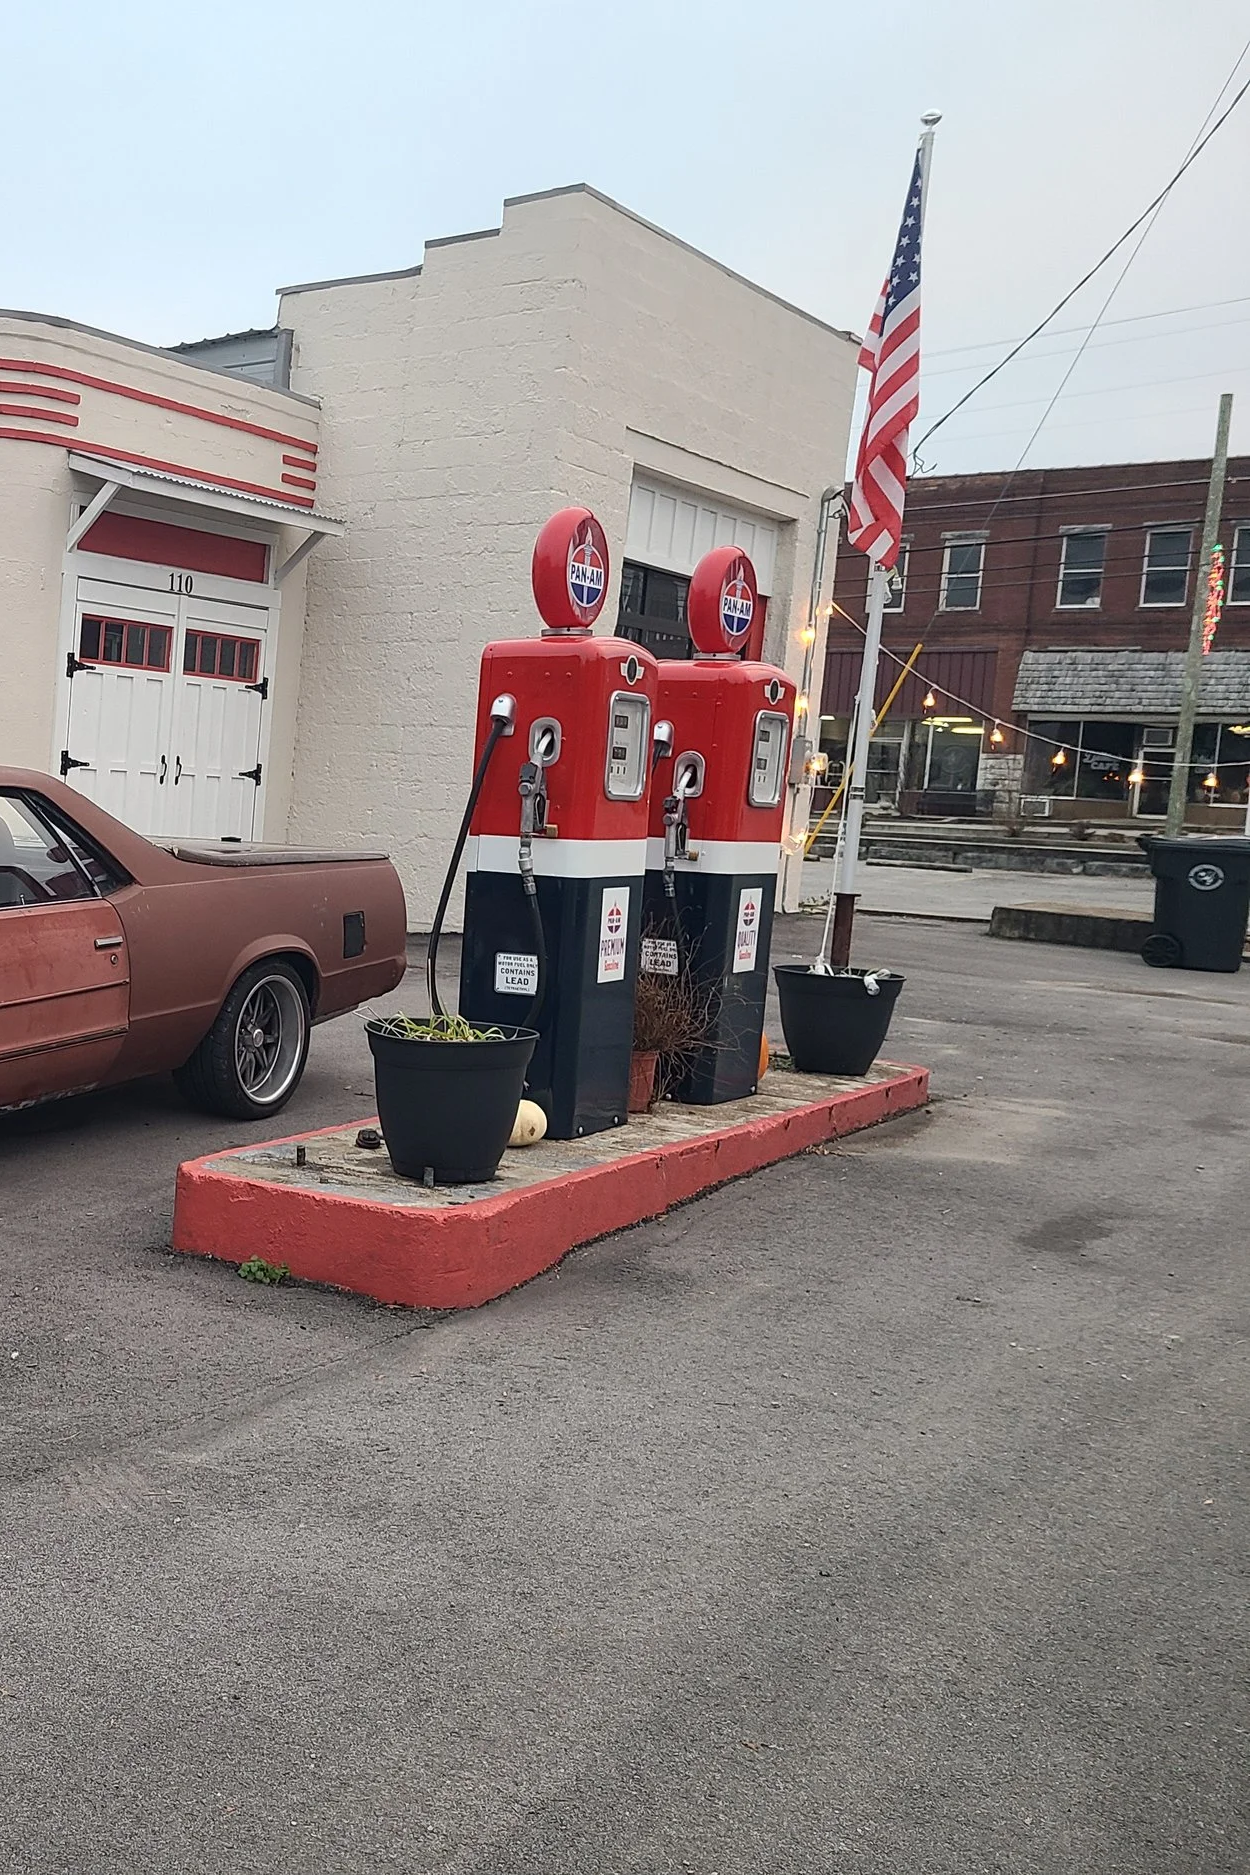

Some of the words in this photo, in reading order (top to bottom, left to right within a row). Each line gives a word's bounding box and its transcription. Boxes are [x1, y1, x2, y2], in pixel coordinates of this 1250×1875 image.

[169, 572, 193, 594] 110
[600, 937, 625, 957] PREMIUM
[645, 950, 677, 960] CONTAINS
[650, 959, 672, 968] LEAD
[500, 967, 535, 977] CONTAINS
[505, 976, 529, 986] LEAD
